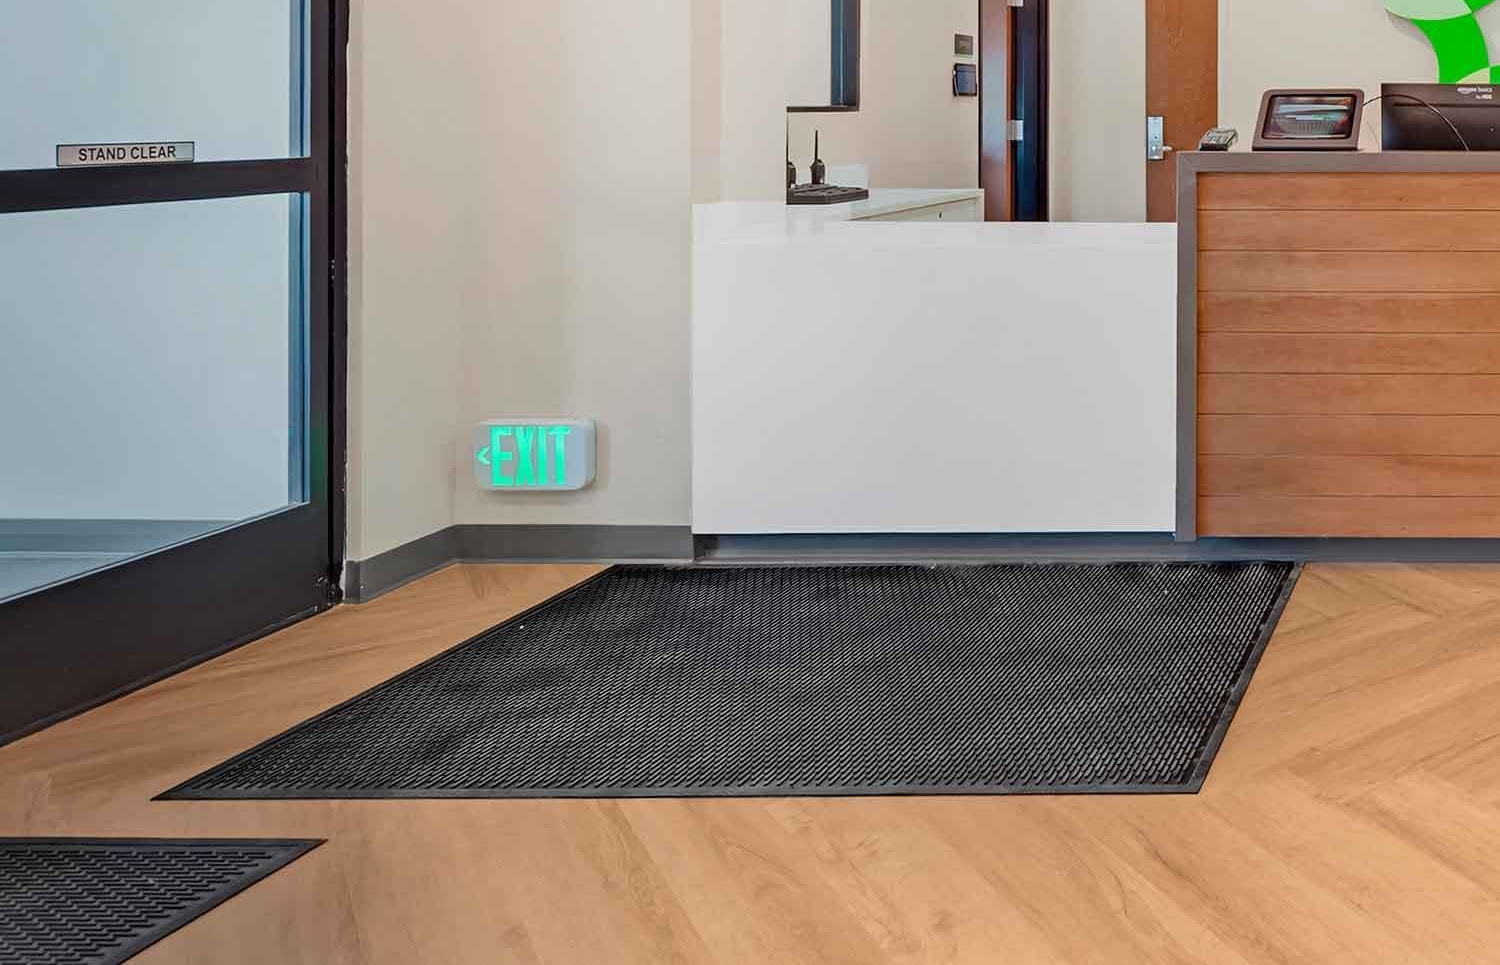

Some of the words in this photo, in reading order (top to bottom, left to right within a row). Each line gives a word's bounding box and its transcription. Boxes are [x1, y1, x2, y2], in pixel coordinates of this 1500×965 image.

[78, 147, 126, 161] STAND
[130, 145, 177, 160] CLEAR
[490, 425, 571, 485] EXIT
